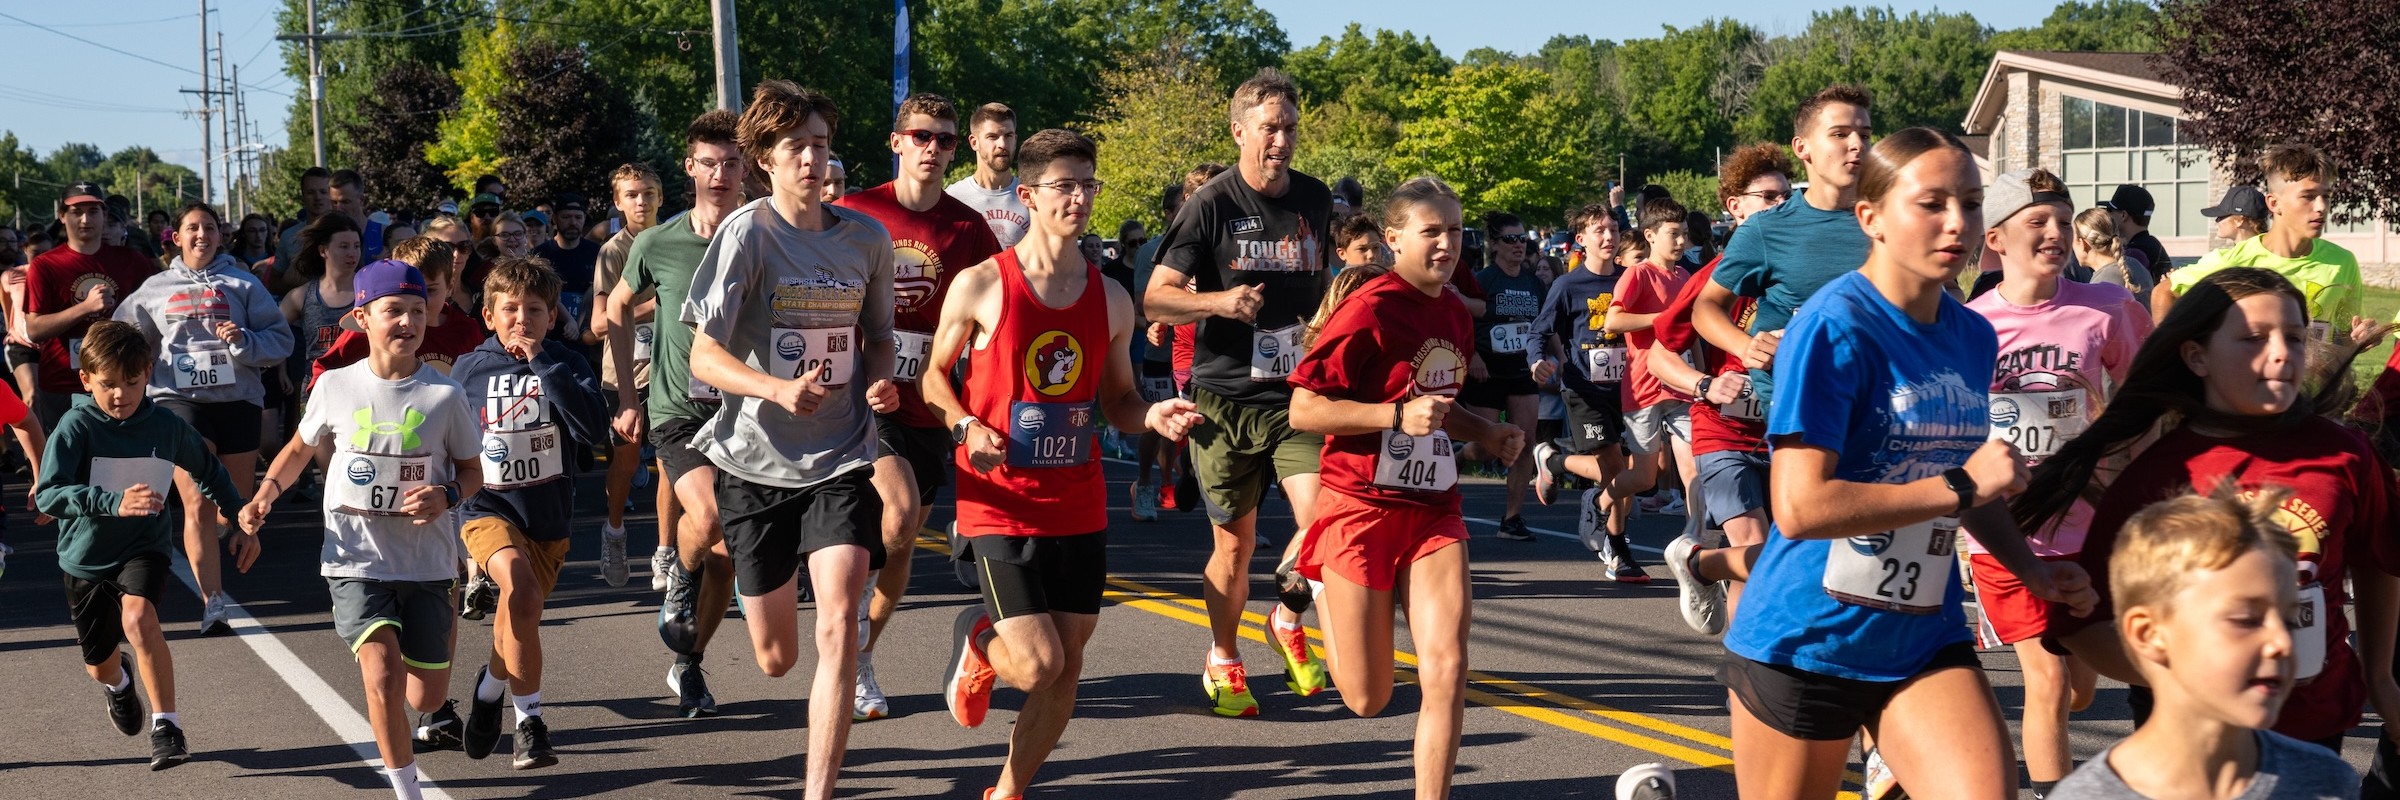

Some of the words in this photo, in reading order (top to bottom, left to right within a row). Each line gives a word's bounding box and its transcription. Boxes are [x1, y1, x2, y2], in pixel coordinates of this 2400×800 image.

[985, 208, 1031, 233] NDAIGU
[1235, 219, 1257, 231] 2014
[913, 240, 929, 253] RUN
[926, 249, 944, 273] SERIES
[1237, 239, 1301, 259] TOUGH
[1236, 257, 1303, 271] MUDDER
[781, 300, 806, 308] STATE
[317, 325, 342, 343] RI
[1503, 337, 1523, 351] 413
[1271, 351, 1297, 376] 401
[1995, 343, 2083, 384] BATTLE
[190, 369, 218, 386] 206
[1071, 410, 1089, 427] FRG
[1032, 435, 1078, 458] 1021
[2009, 425, 2056, 454] 207
[402, 464, 425, 481] FRG
[500, 457, 540, 483] 200
[1398, 459, 1438, 487] 404
[370, 484, 399, 510] 67
[2289, 497, 2330, 539] SERIES
[1876, 557, 1922, 601] 23
